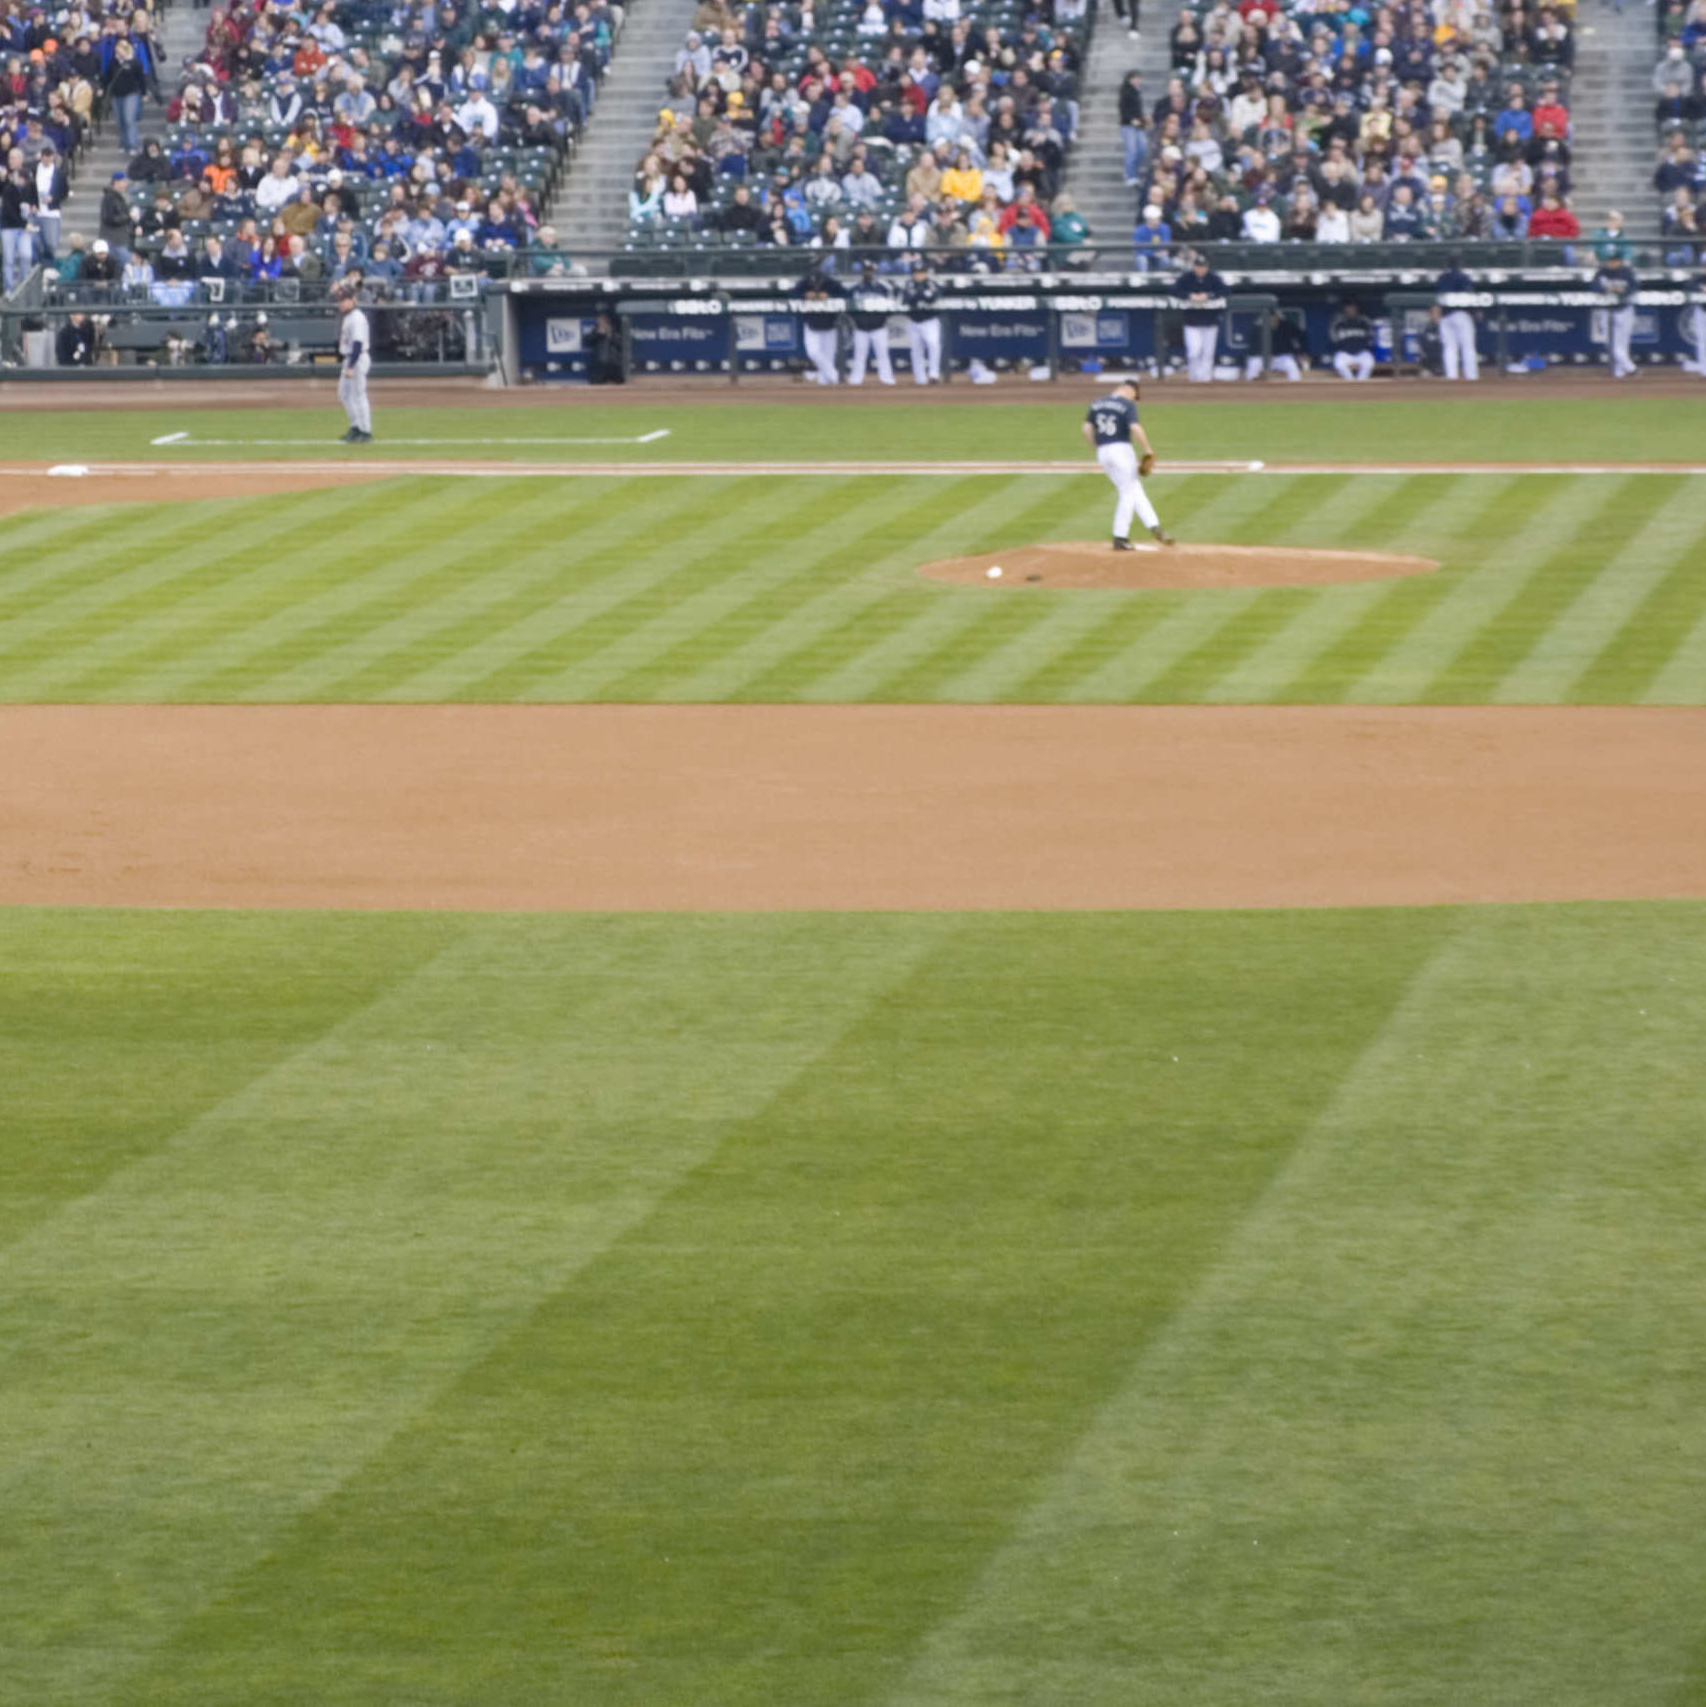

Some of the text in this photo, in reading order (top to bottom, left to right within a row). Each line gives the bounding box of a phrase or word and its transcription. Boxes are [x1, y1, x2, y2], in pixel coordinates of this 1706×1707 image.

[658, 326, 681, 341] Era
[989, 323, 1012, 338] Era
[1095, 413, 1118, 436] 56
